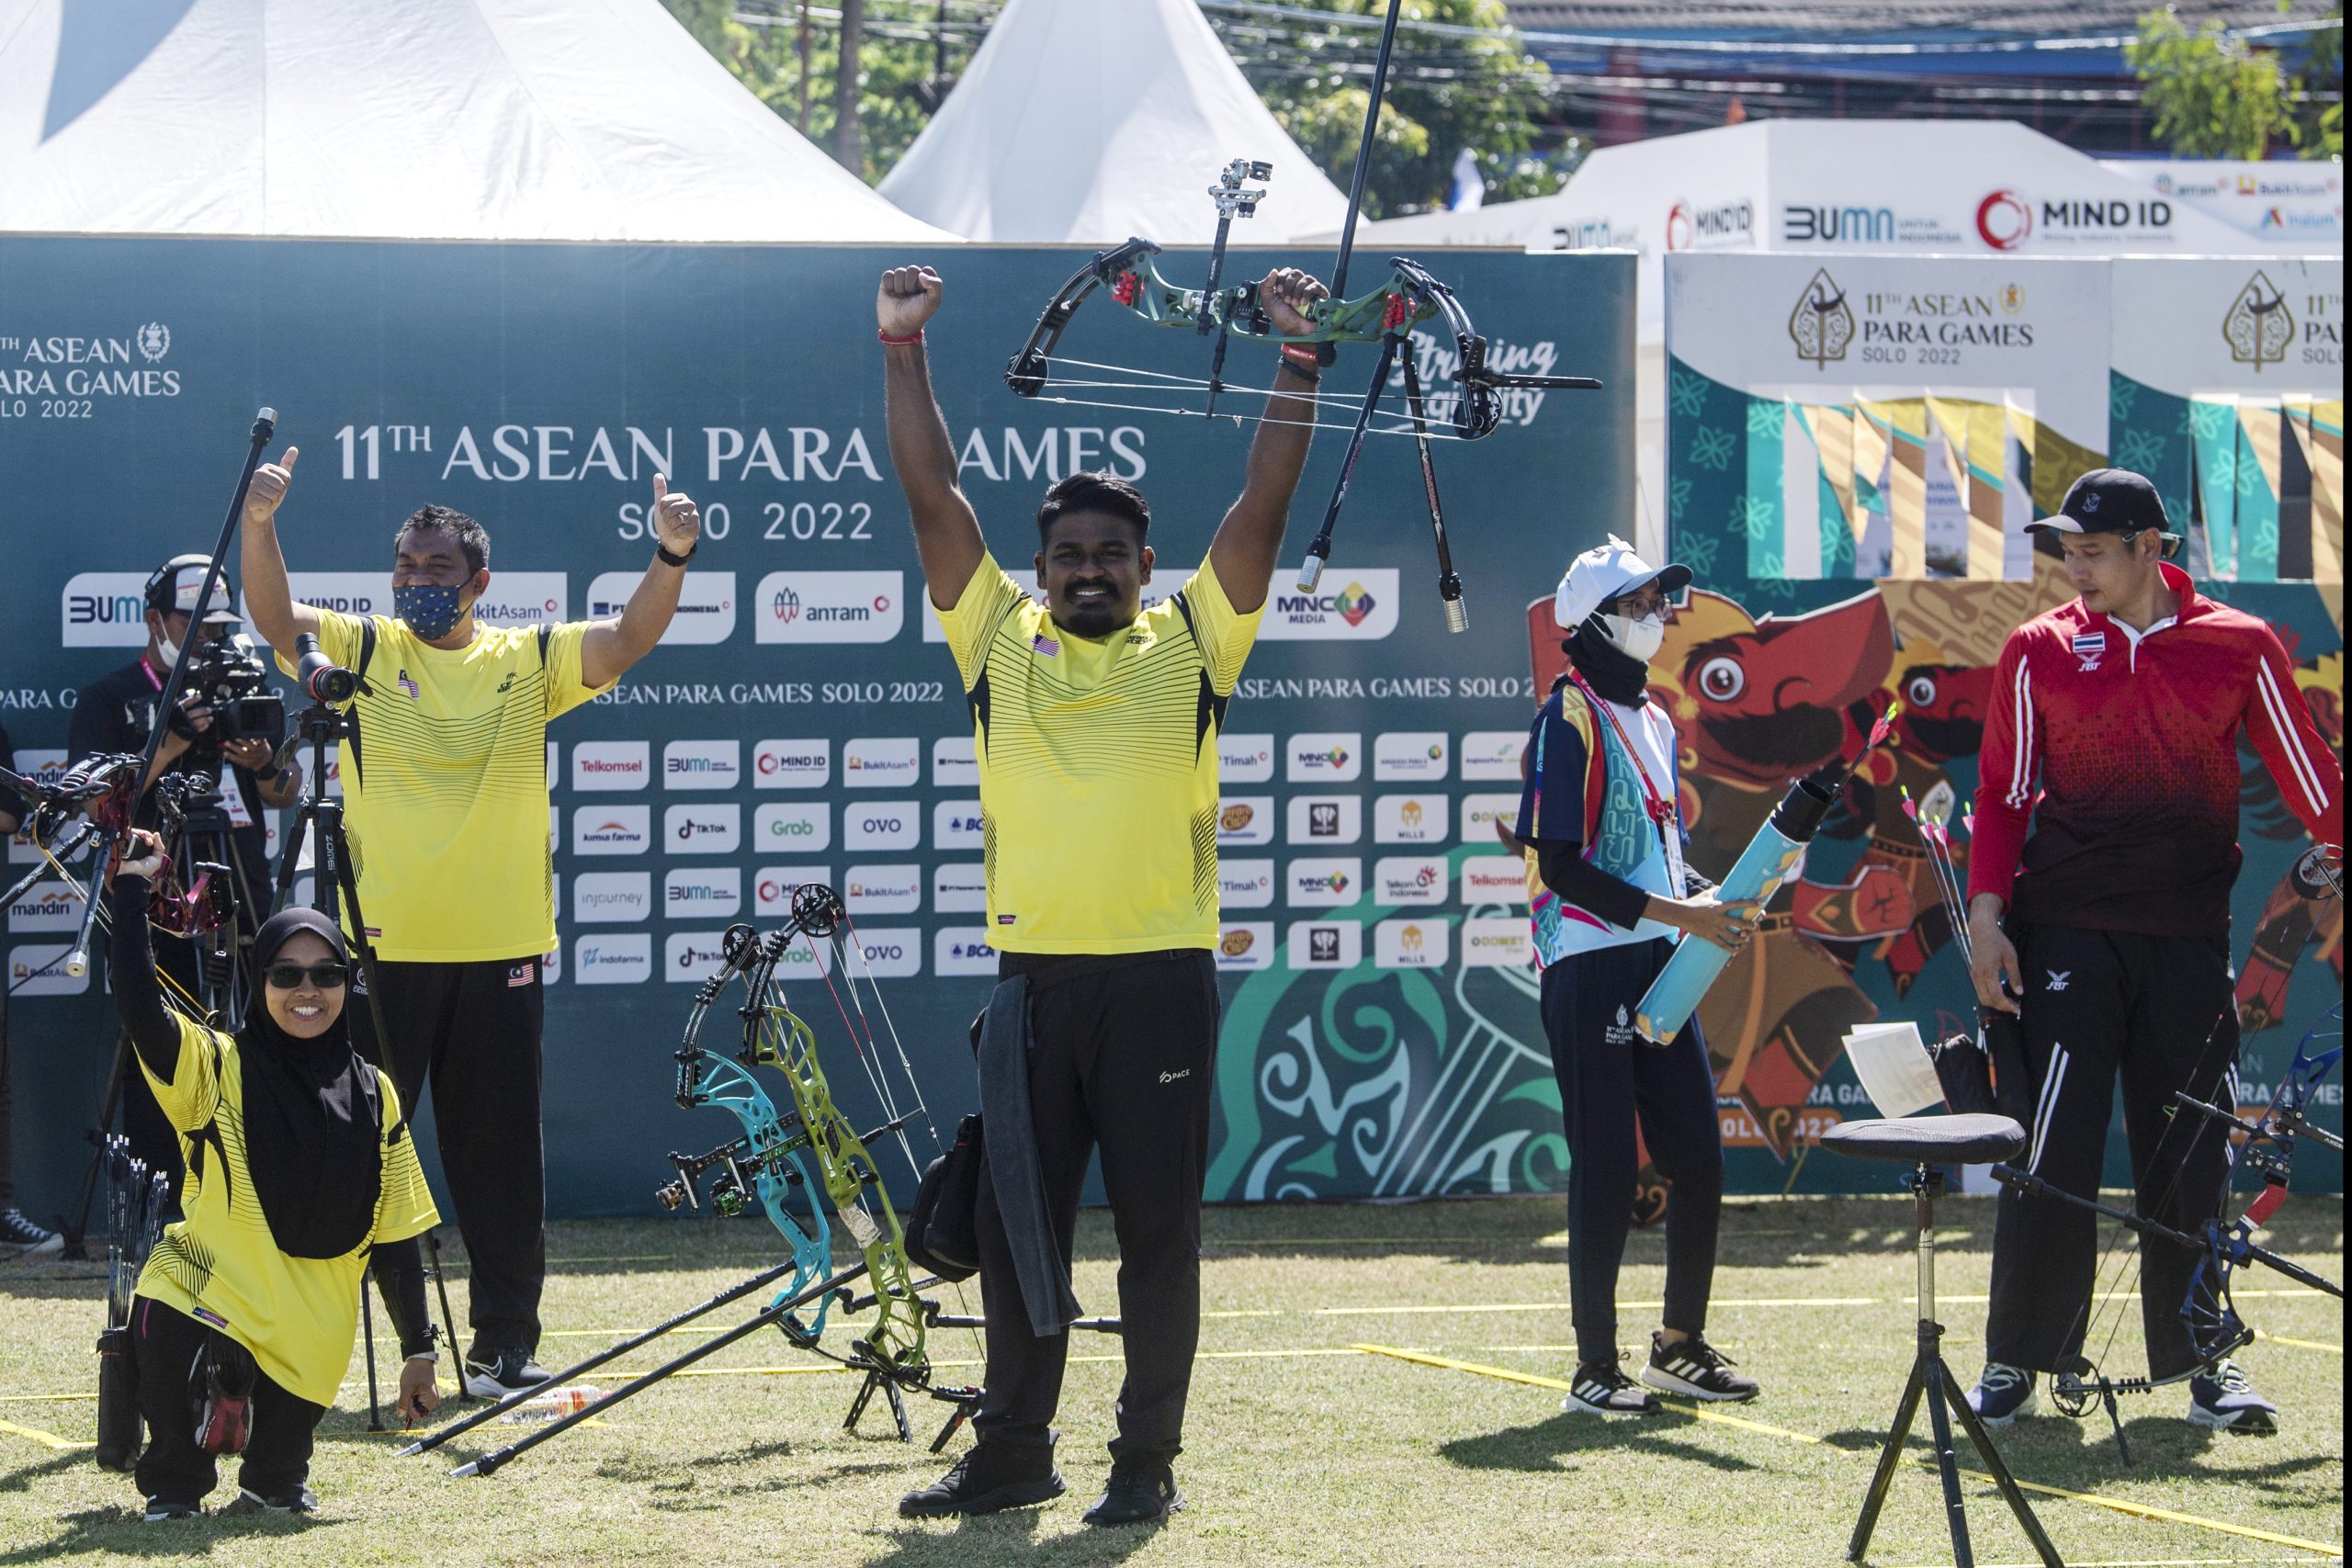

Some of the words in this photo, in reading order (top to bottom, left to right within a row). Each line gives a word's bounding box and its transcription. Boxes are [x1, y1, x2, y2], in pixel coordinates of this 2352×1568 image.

[2042, 200, 2131, 228] MIND
[2140, 200, 2172, 227] ID
[1785, 207, 1894, 241] BUMN
[1905, 294, 1993, 317] ASEAN
[1863, 321, 1932, 344] PARA
[1939, 321, 2034, 347] GAMES
[2304, 321, 2343, 344] PA
[23, 336, 131, 365] ASEAN
[1862, 346, 1906, 364] SOLO
[1918, 348, 1962, 365] 2022
[65, 368, 182, 398] GAMES
[40, 400, 93, 419] 2022
[441, 424, 673, 482] ASEAN
[702, 425, 884, 482] PARA
[957, 425, 1147, 483] AMES
[618, 502, 730, 541] SO
[763, 502, 873, 541] 2022
[69, 595, 147, 624] BUM
[352, 597, 372, 614] ID
[472, 602, 542, 620] kitAsam
[675, 605, 720, 614] NDONESIA
[1277, 595, 1337, 613] MNC
[1288, 614, 1327, 625] MEDIA
[665, 684, 726, 705] PARA
[730, 683, 814, 705] GAMES
[822, 683, 884, 704] SOLO
[889, 682, 944, 703] 2022
[1232, 679, 1304, 700] ASEAN
[1307, 679, 1365, 699] PARA
[1370, 678, 1452, 699] GAMES
[1459, 677, 1518, 698] SOLO
[668, 757, 710, 773] BUMN
[781, 756, 811, 767] MIND
[813, 756, 826, 766] ID
[864, 760, 910, 770] BukitAsam
[1224, 755, 1258, 766] Timah
[1298, 753, 1329, 762] MNC
[581, 760, 642, 773] Telkomsel
[696, 824, 727, 833] TikTok
[771, 818, 813, 836] Grab
[863, 818, 901, 834] OVO
[965, 818, 984, 831] BC
[582, 832, 610, 842] kimia
[612, 832, 641, 841] farma
[1397, 829, 1426, 839] MILLS
[1224, 880, 1258, 891] Timah
[1298, 877, 1329, 887] MNC
[1386, 879, 1416, 888] Telkom
[582, 892, 643, 908] injourney
[669, 886, 711, 901] BUMN
[865, 887, 910, 897] BukitAsam
[12, 900, 70, 916] mandiri
[600, 954, 644, 964] indofarma
[865, 945, 902, 960] OVO
[967, 944, 996, 958] BCA
[1397, 955, 1426, 964] MILLS
[1172, 1068, 1191, 1080] PACE
